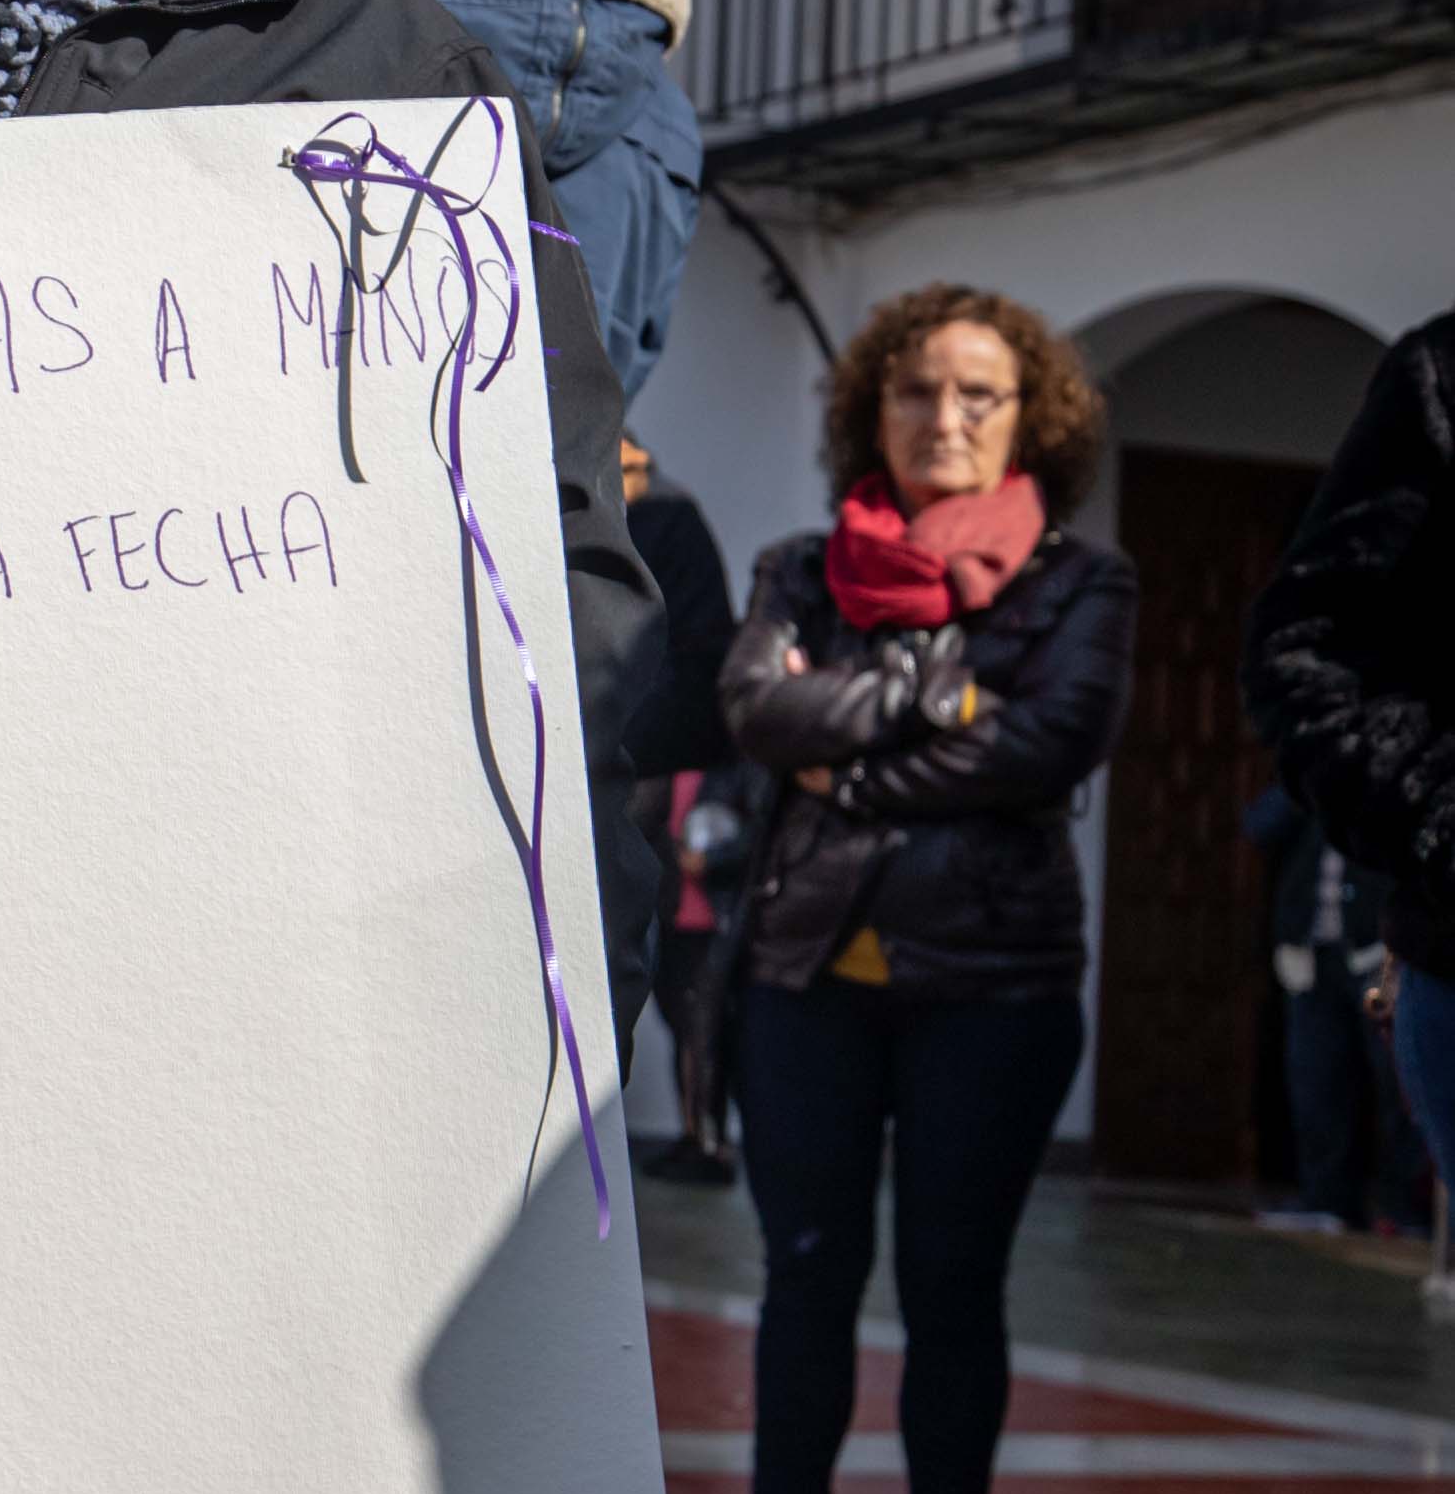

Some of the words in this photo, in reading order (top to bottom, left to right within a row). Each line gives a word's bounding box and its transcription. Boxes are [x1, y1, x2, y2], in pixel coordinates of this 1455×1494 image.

[155, 278, 196, 383] A
[271, 246, 516, 376] MANOS
[62, 491, 337, 593] FECHA
